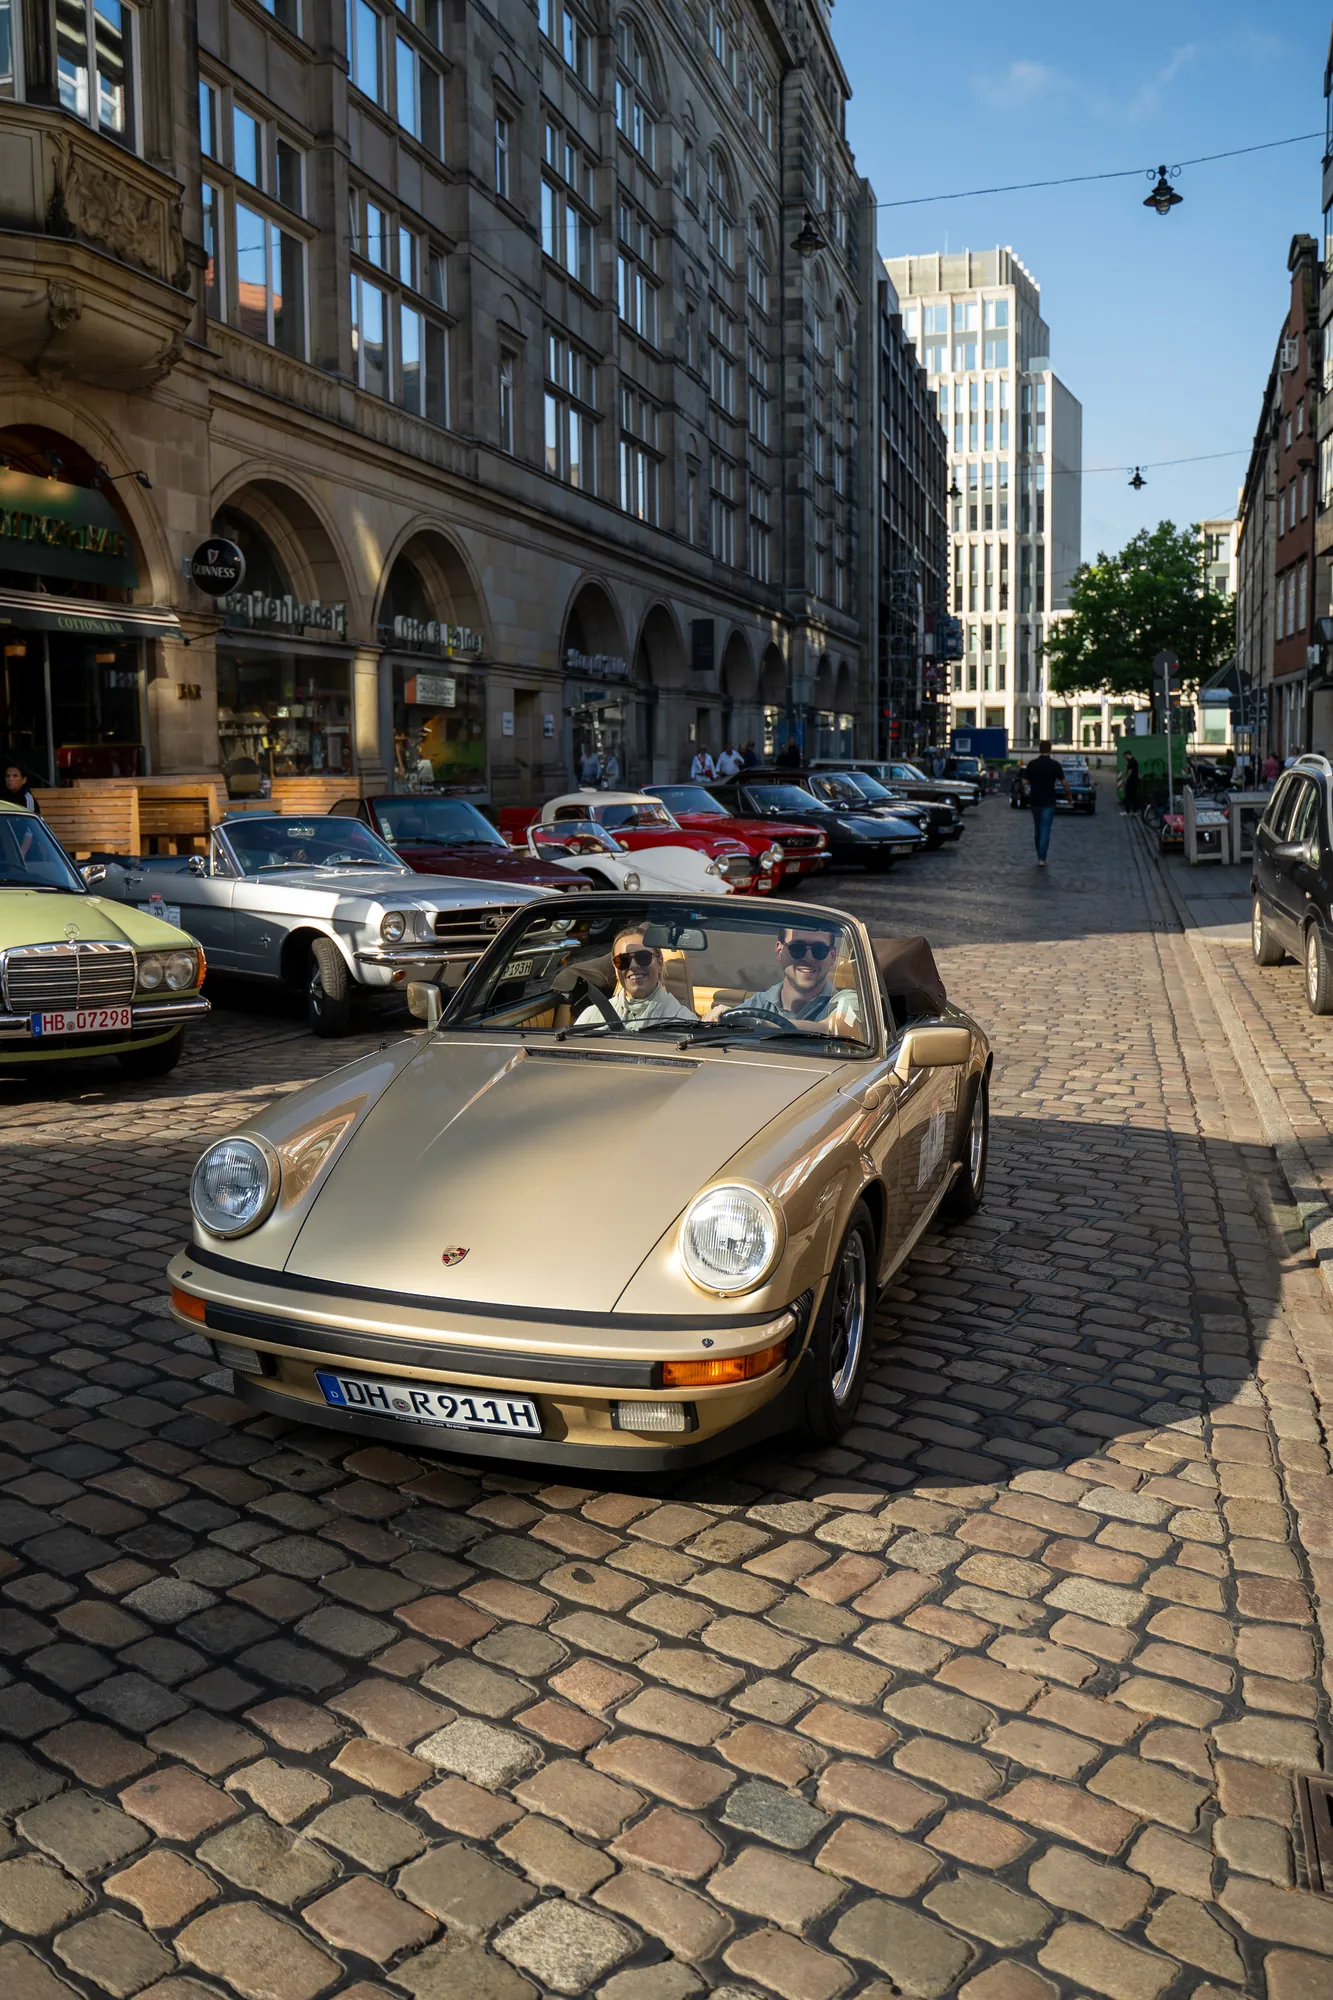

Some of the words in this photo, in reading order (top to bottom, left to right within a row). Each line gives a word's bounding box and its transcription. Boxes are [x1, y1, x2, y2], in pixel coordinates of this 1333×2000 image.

[192, 562, 236, 579] GUINNESS
[177, 683, 202, 700] BAR
[43, 1014, 65, 1032] HB
[76, 1009, 129, 1030] 07298
[341, 1379, 390, 1410] DH
